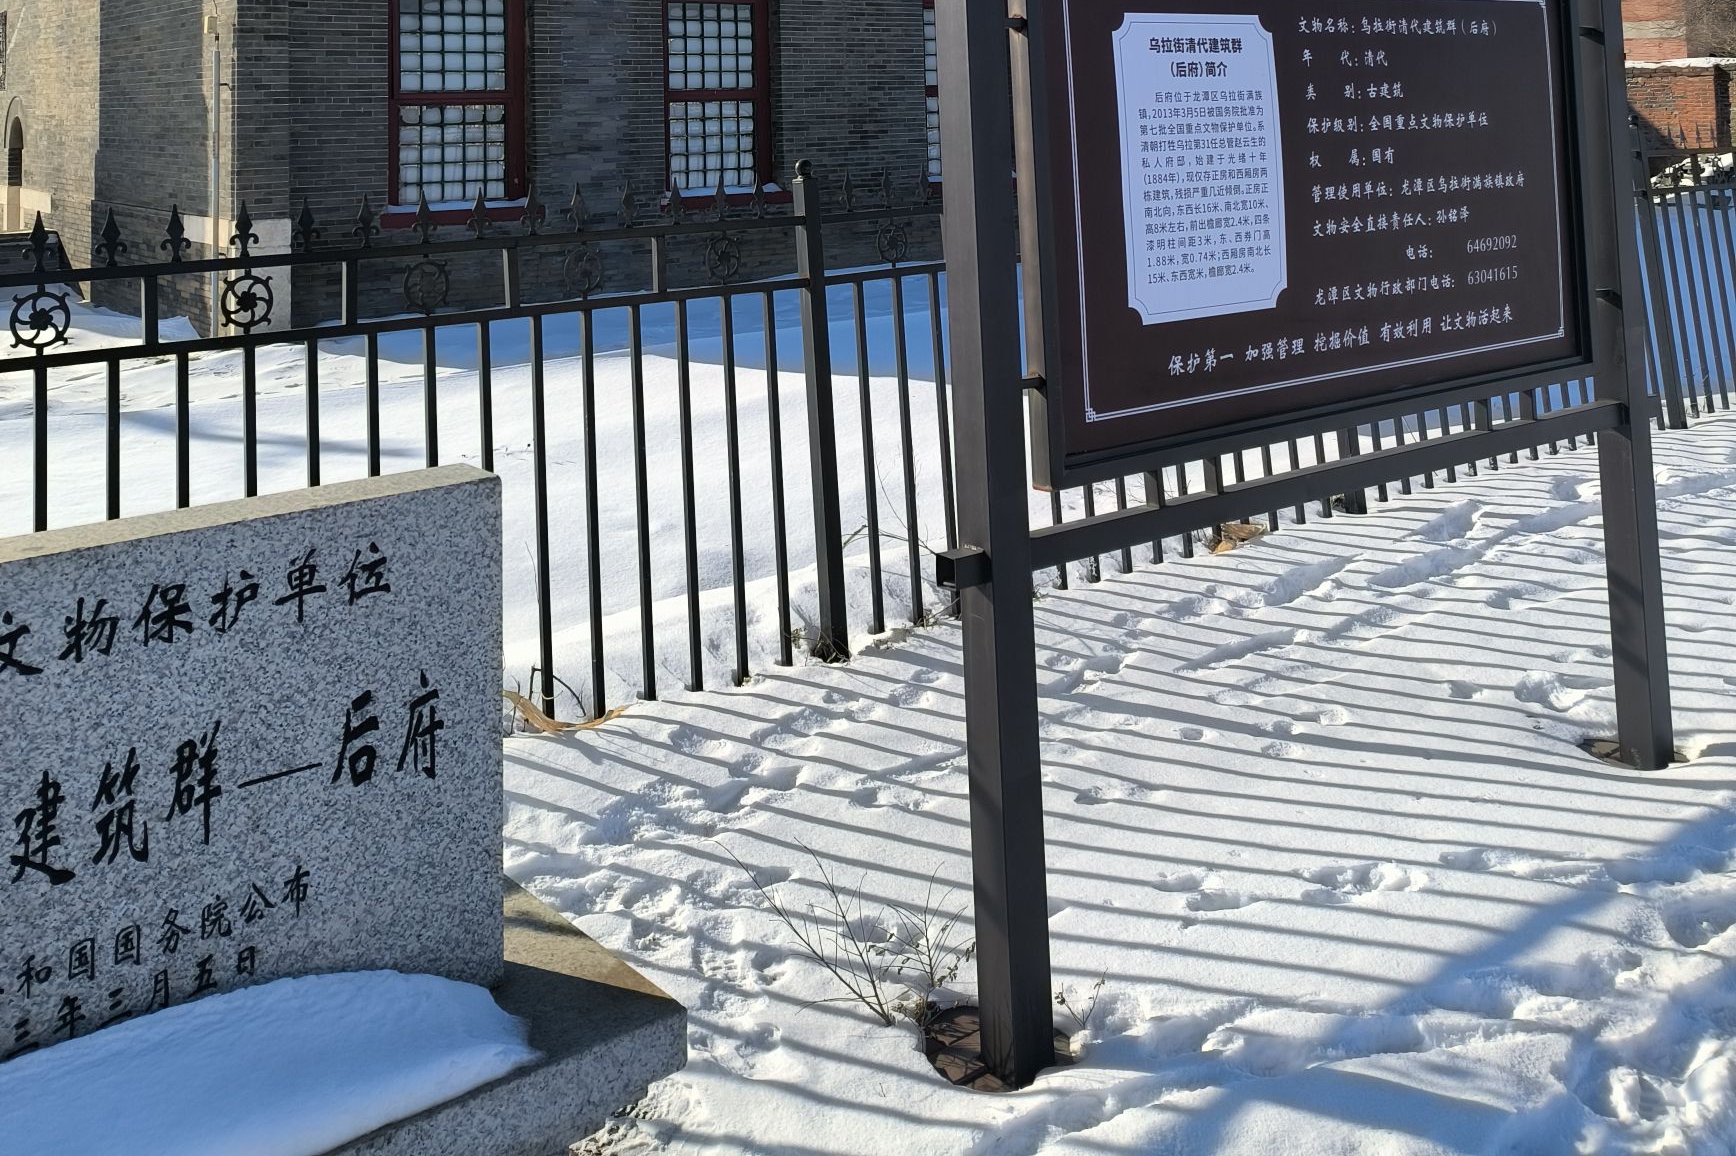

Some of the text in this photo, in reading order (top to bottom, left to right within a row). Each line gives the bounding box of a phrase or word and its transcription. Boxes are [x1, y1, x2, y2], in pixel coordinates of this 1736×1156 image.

[1148, 37, 1243, 54] 乌拉街清代建筑群
[1302, 48, 1313, 67] 年
[1170, 61, 1228, 77] （后府）简介
[1155, 90, 1263, 103] 后府位于龙潭区乌拉街满族
[1306, 82, 1317, 101] 类
[1307, 110, 1489, 134] 保护级别：全国重点文物保护单位
[1309, 151, 1322, 168] 权
[1467, 234, 1517, 254] 64692092
[1467, 266, 1518, 285] 63041615
[1168, 303, 1513, 376] 保护第一 加强管理 挖掘价值 有效利用 让文物活起来
[0, 866, 310, 999] 和国国务院公布
